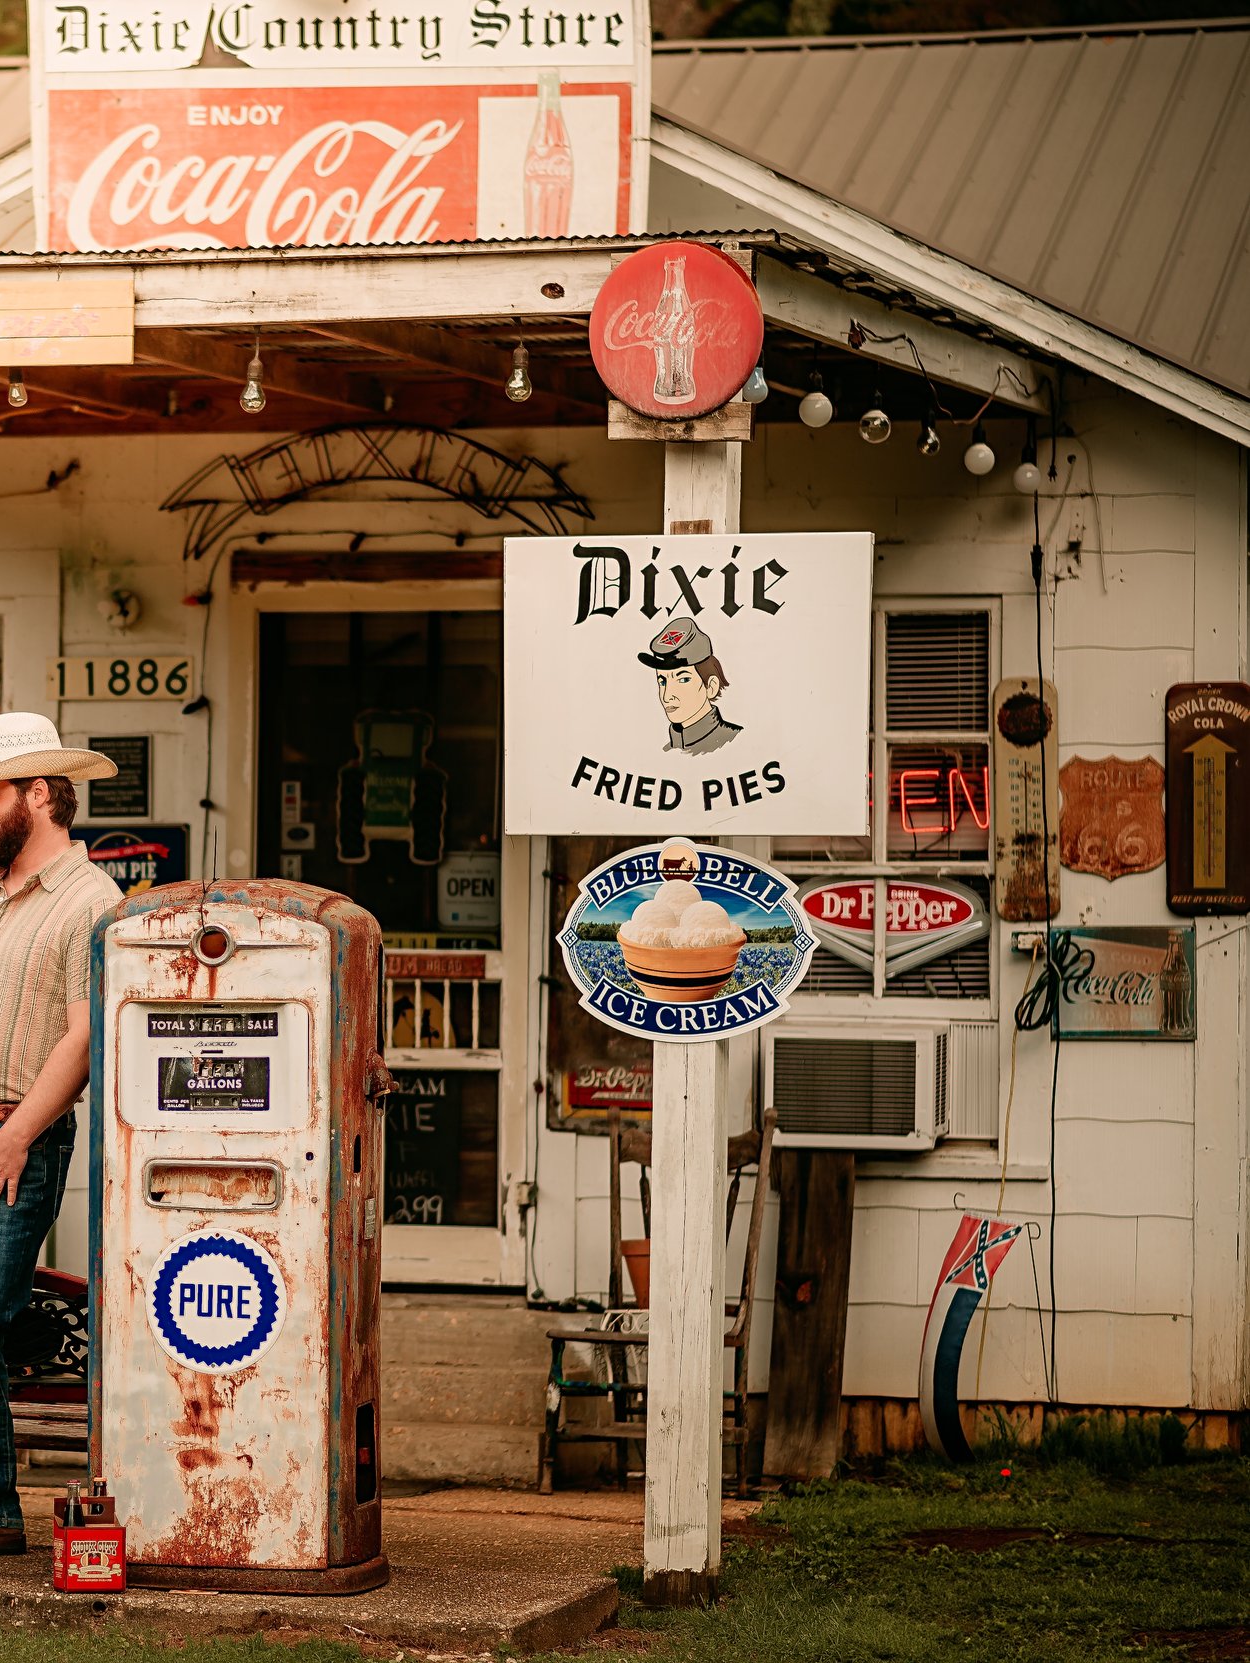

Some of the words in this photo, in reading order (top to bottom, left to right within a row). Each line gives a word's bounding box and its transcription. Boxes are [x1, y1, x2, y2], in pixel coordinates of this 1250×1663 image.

[55, 5, 190, 54] Dixie
[218, 3, 442, 62] Country
[469, 0, 624, 48] Store
[188, 105, 284, 127] ENJOY
[67, 119, 465, 252] Coca-Cola
[572, 541, 790, 626] Dixie
[56, 659, 188, 696] 11886
[1167, 696, 1206, 724] ROYAL
[1208, 696, 1250, 723] CROWN
[1193, 717, 1225, 729] COLA
[571, 755, 683, 811] FRIED
[703, 761, 787, 812] PIES
[1080, 767, 1146, 789] ROUTE
[1077, 822, 1149, 866] 66
[130, 861, 157, 880] PIE
[590, 855, 656, 910] BLUE
[703, 857, 779, 909] BELL
[447, 877, 495, 898] OPEN
[821, 891, 857, 919] Dr
[592, 980, 647, 1026] ICE
[654, 987, 775, 1034] CREAM
[151, 1020, 186, 1030] TOTAL
[247, 1019, 274, 1030] SALE
[186, 1078, 243, 1090] GALLONS
[398, 1077, 447, 1096] EAM
[179, 1283, 252, 1319] PURE
